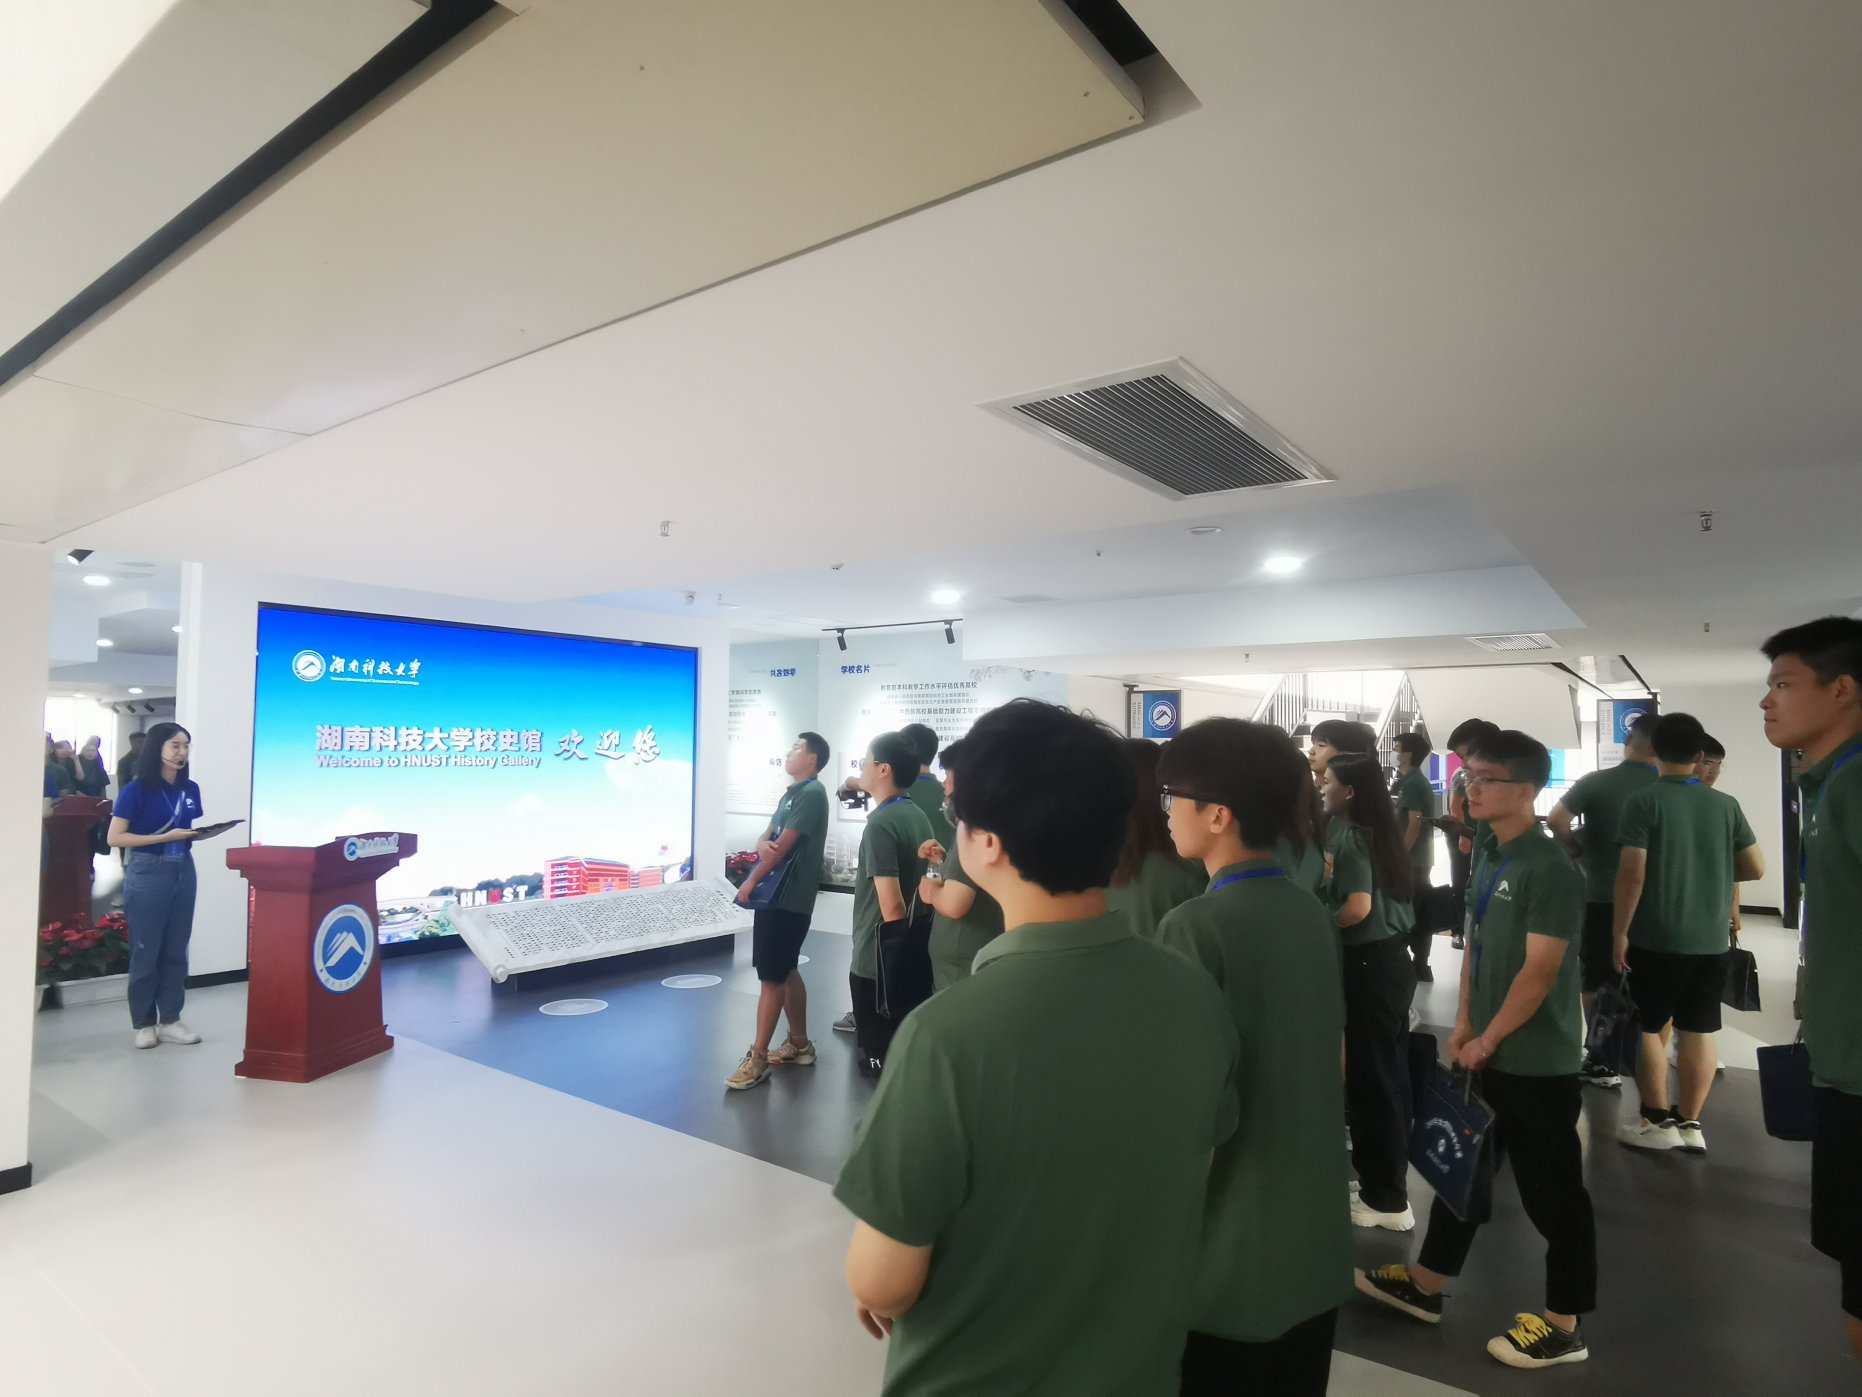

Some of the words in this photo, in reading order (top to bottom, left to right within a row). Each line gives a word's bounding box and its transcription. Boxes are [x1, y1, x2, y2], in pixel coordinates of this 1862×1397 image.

[329, 655, 421, 678] 湖南科技大学
[841, 664, 870, 674] 学校名片
[315, 724, 543, 752] 湖南科技大学校史馆
[554, 724, 660, 765] 欢迎您
[317, 754, 382, 767] Welcome
[384, 755, 399, 767] to
[402, 754, 449, 767] HNUST
[453, 755, 496, 769] History
[500, 754, 541, 768] Gallery
[460, 885, 528, 907] HNUST
